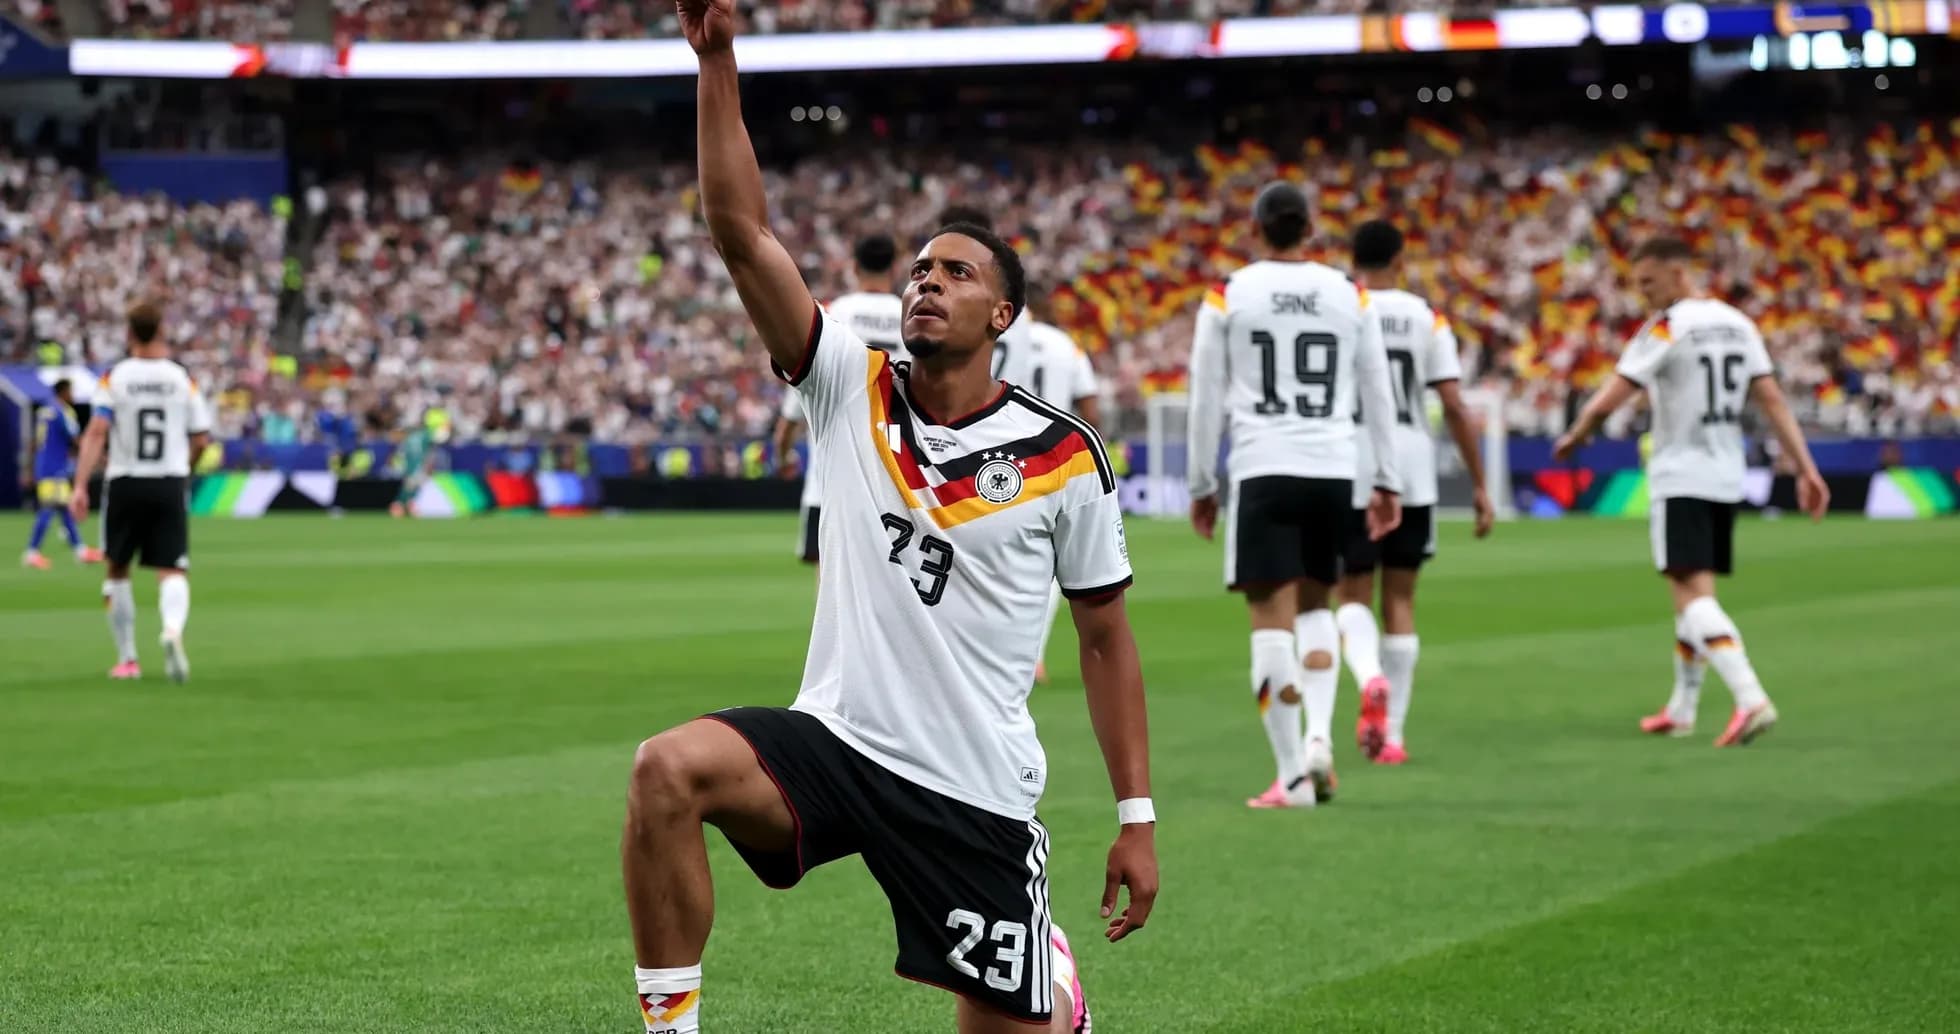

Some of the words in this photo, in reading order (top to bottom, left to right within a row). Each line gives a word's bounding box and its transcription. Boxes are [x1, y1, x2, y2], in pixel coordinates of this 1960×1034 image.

[1251, 331, 1338, 418] 19
[1699, 354, 1744, 423] 15
[137, 408, 166, 460] 6
[881, 512, 954, 607] 23
[946, 908, 1027, 992] 23
